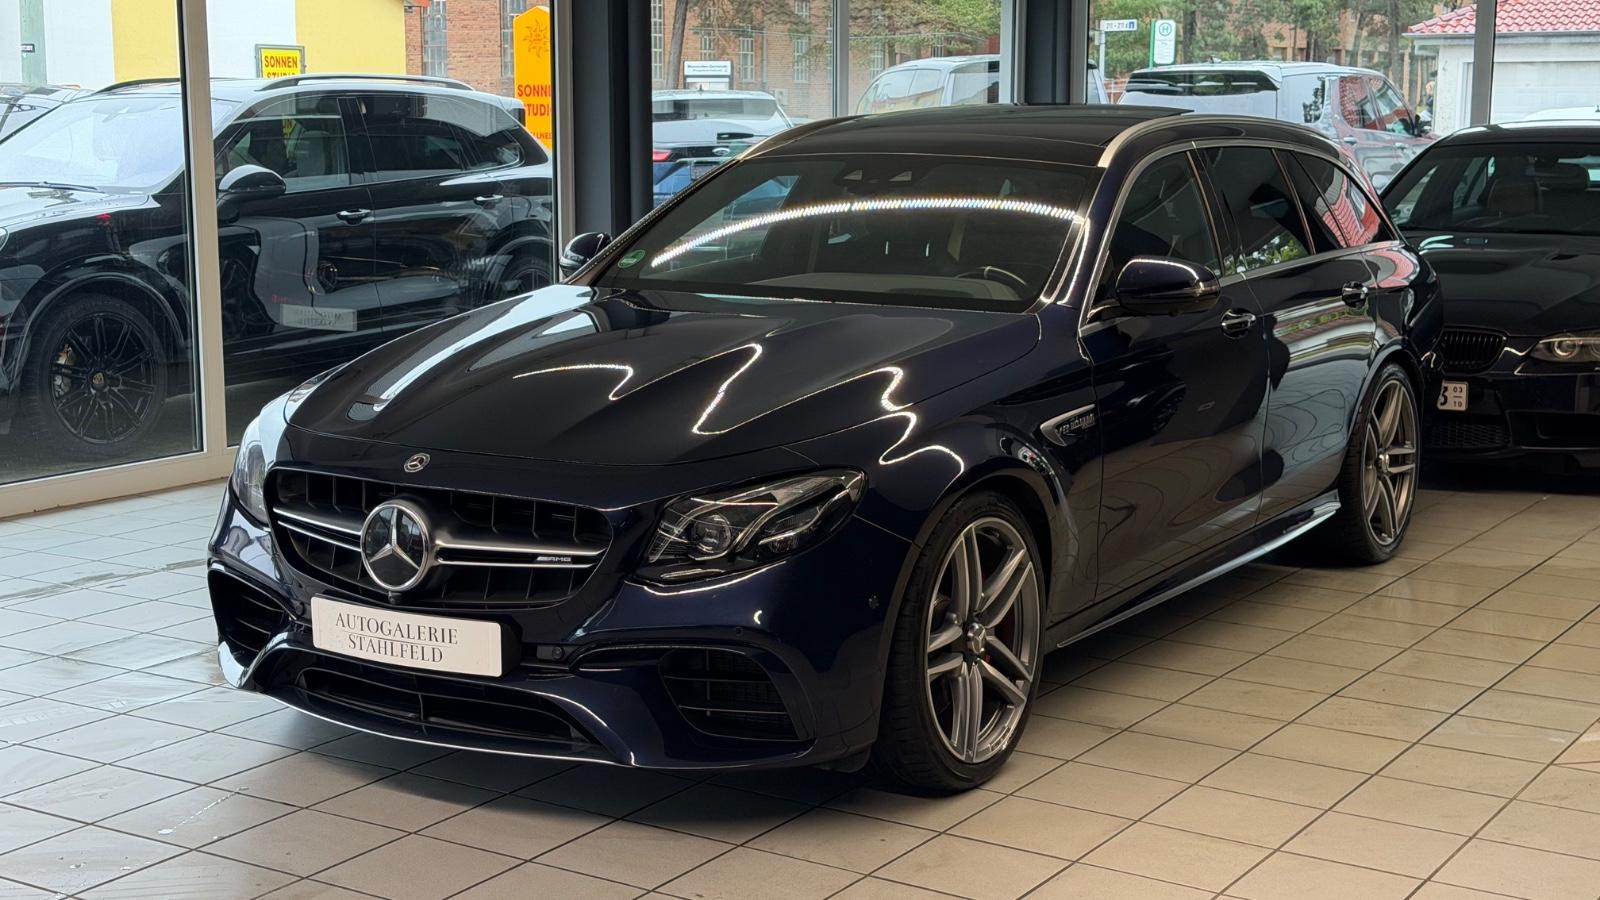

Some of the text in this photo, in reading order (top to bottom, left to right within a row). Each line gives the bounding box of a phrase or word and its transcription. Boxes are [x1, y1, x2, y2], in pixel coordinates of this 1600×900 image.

[264, 55, 298, 69] SONNEN
[525, 103, 552, 117] TUDI
[335, 612, 458, 646] AUTOGALERIE
[348, 633, 444, 663] STAHLFELD
